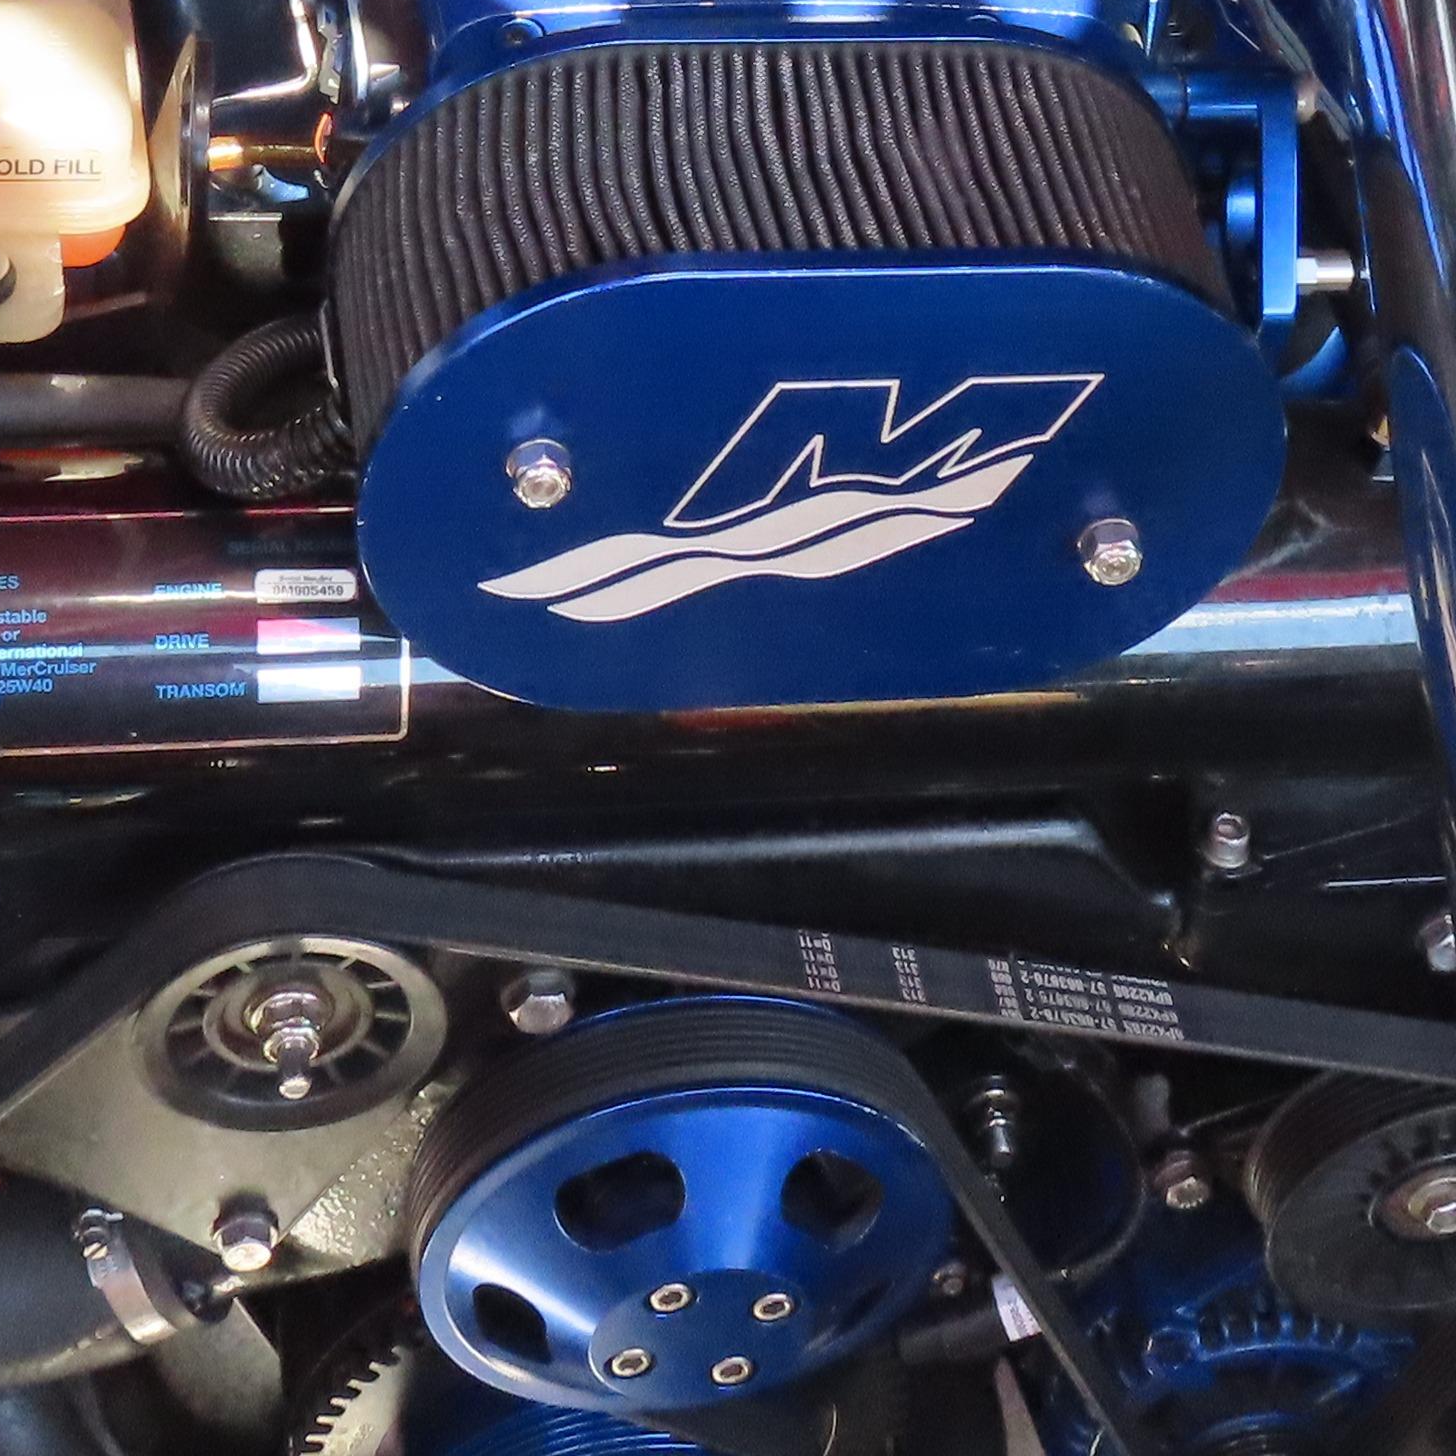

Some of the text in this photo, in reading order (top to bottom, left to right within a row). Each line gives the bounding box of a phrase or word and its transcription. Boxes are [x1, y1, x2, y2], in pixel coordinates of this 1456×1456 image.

[54, 159, 102, 175] FILL
[0, 630, 22, 643] or
[155, 633, 210, 650] DRIVE
[155, 681, 248, 699] TRANSOM
